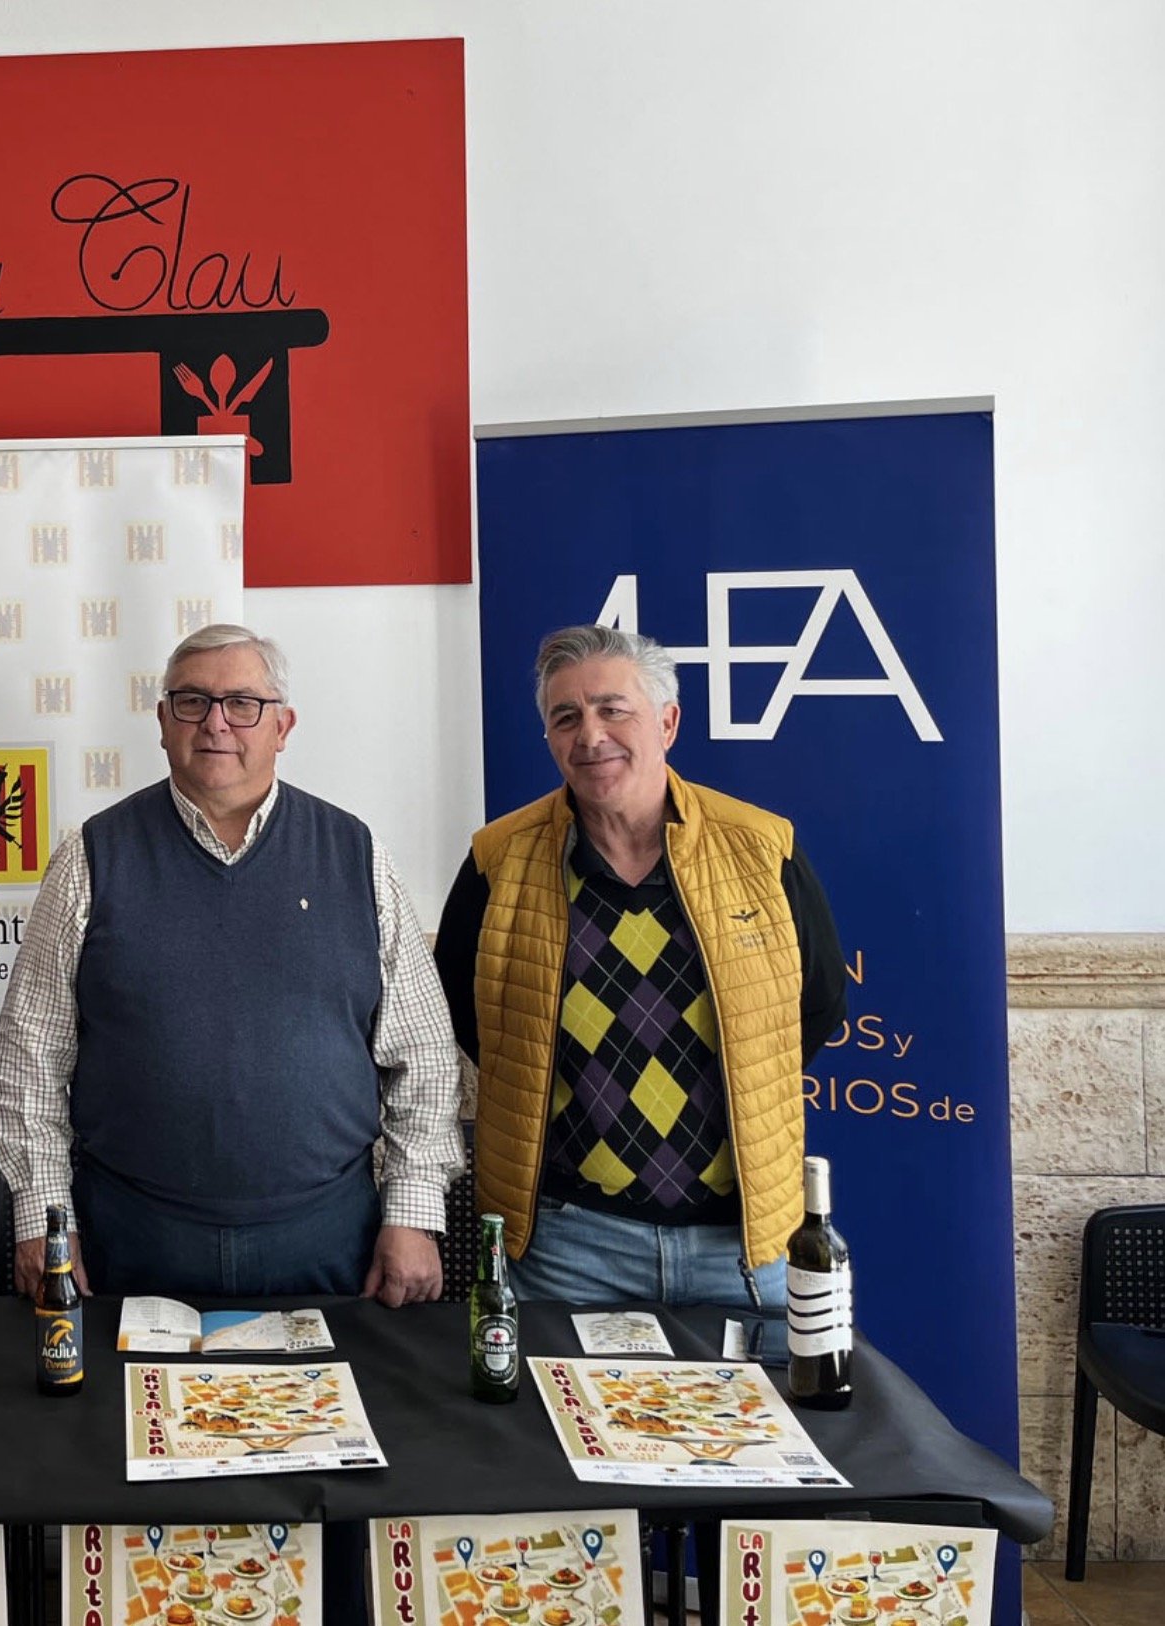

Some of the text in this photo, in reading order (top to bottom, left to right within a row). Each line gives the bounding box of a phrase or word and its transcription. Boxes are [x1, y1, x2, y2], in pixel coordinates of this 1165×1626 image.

[52, 174, 296, 311] Clau
[893, 1033, 913, 1058] y
[929, 1095, 975, 1122] de
[388, 1523, 411, 1539] LA
[739, 1534, 763, 1549] LA
